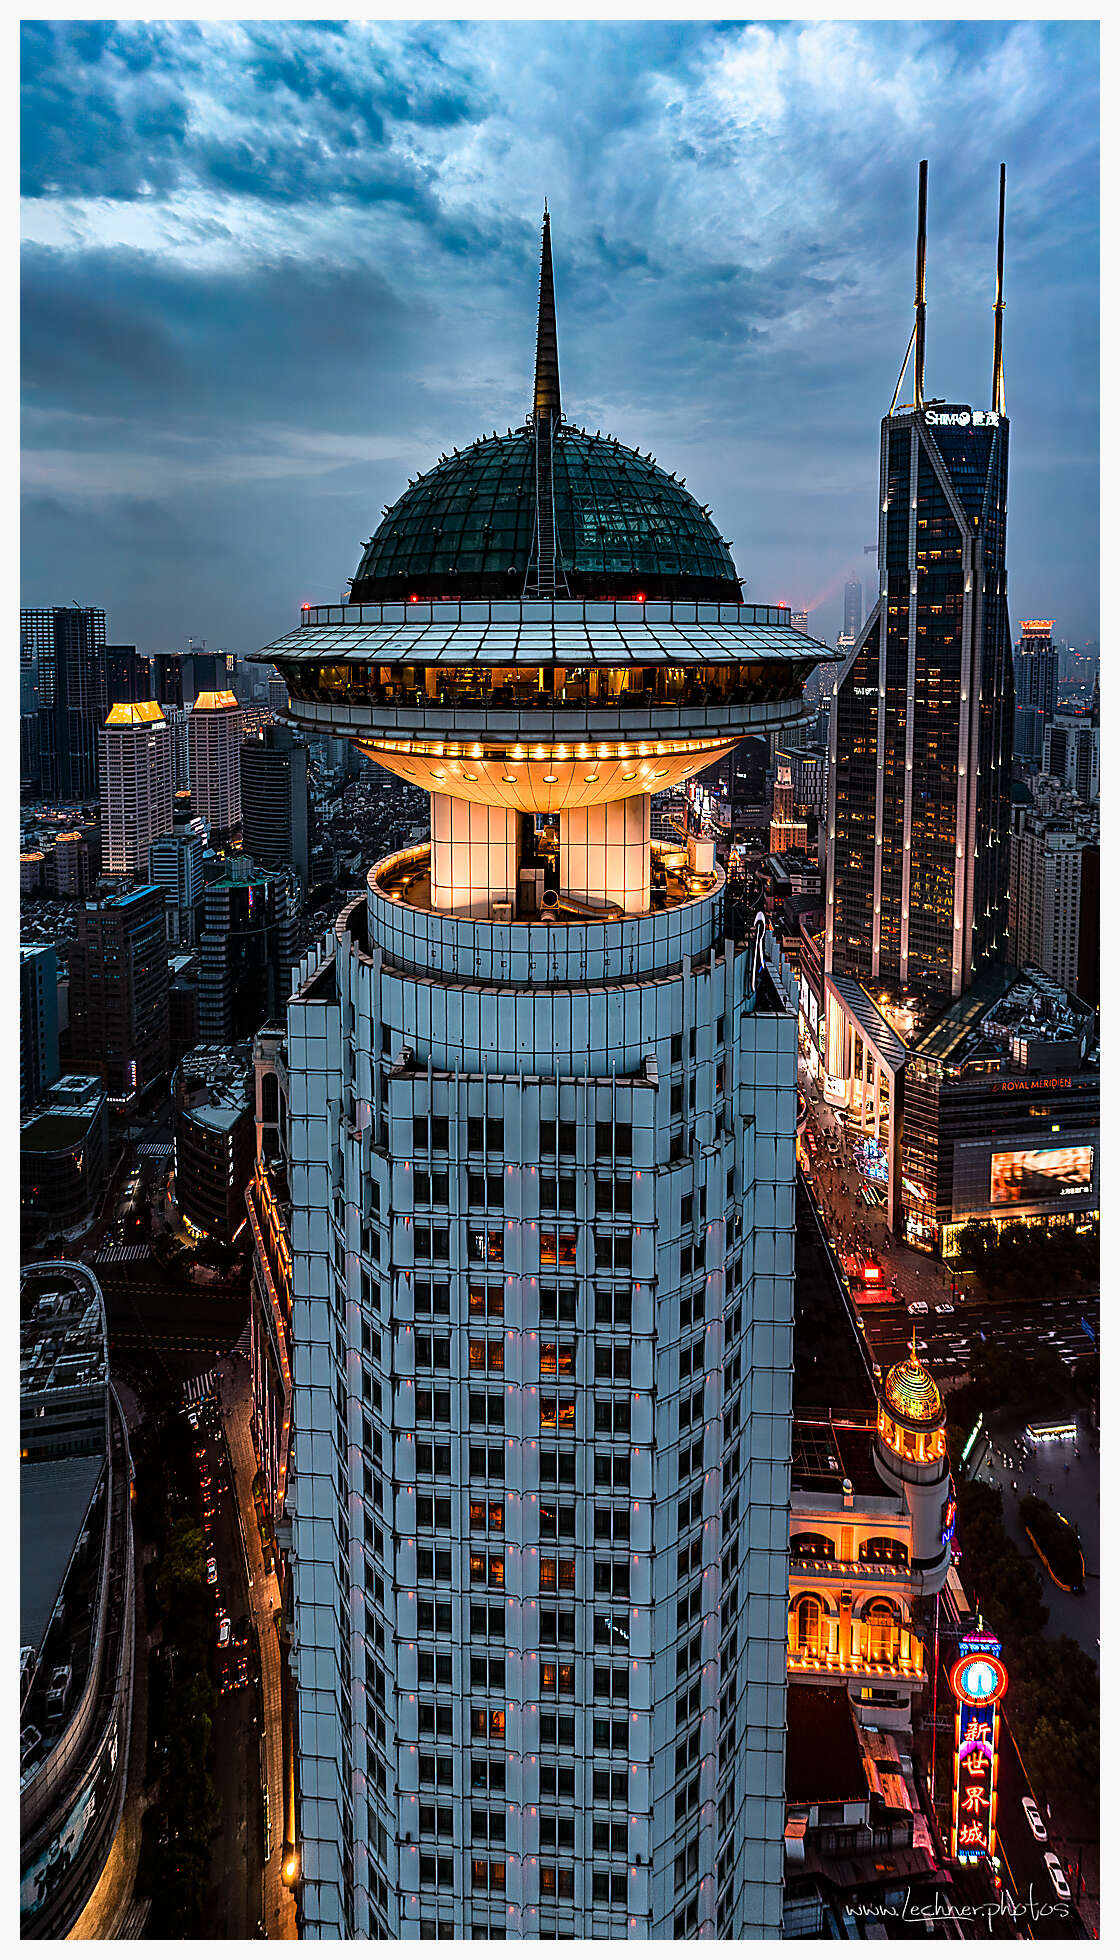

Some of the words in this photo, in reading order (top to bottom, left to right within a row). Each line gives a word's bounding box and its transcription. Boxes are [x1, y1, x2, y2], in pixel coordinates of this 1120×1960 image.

[1002, 1081, 1029, 1091] ROYAL
[1031, 1078, 1071, 1089] MERIDIEN
[959, 1717, 991, 1848] 新世界城
